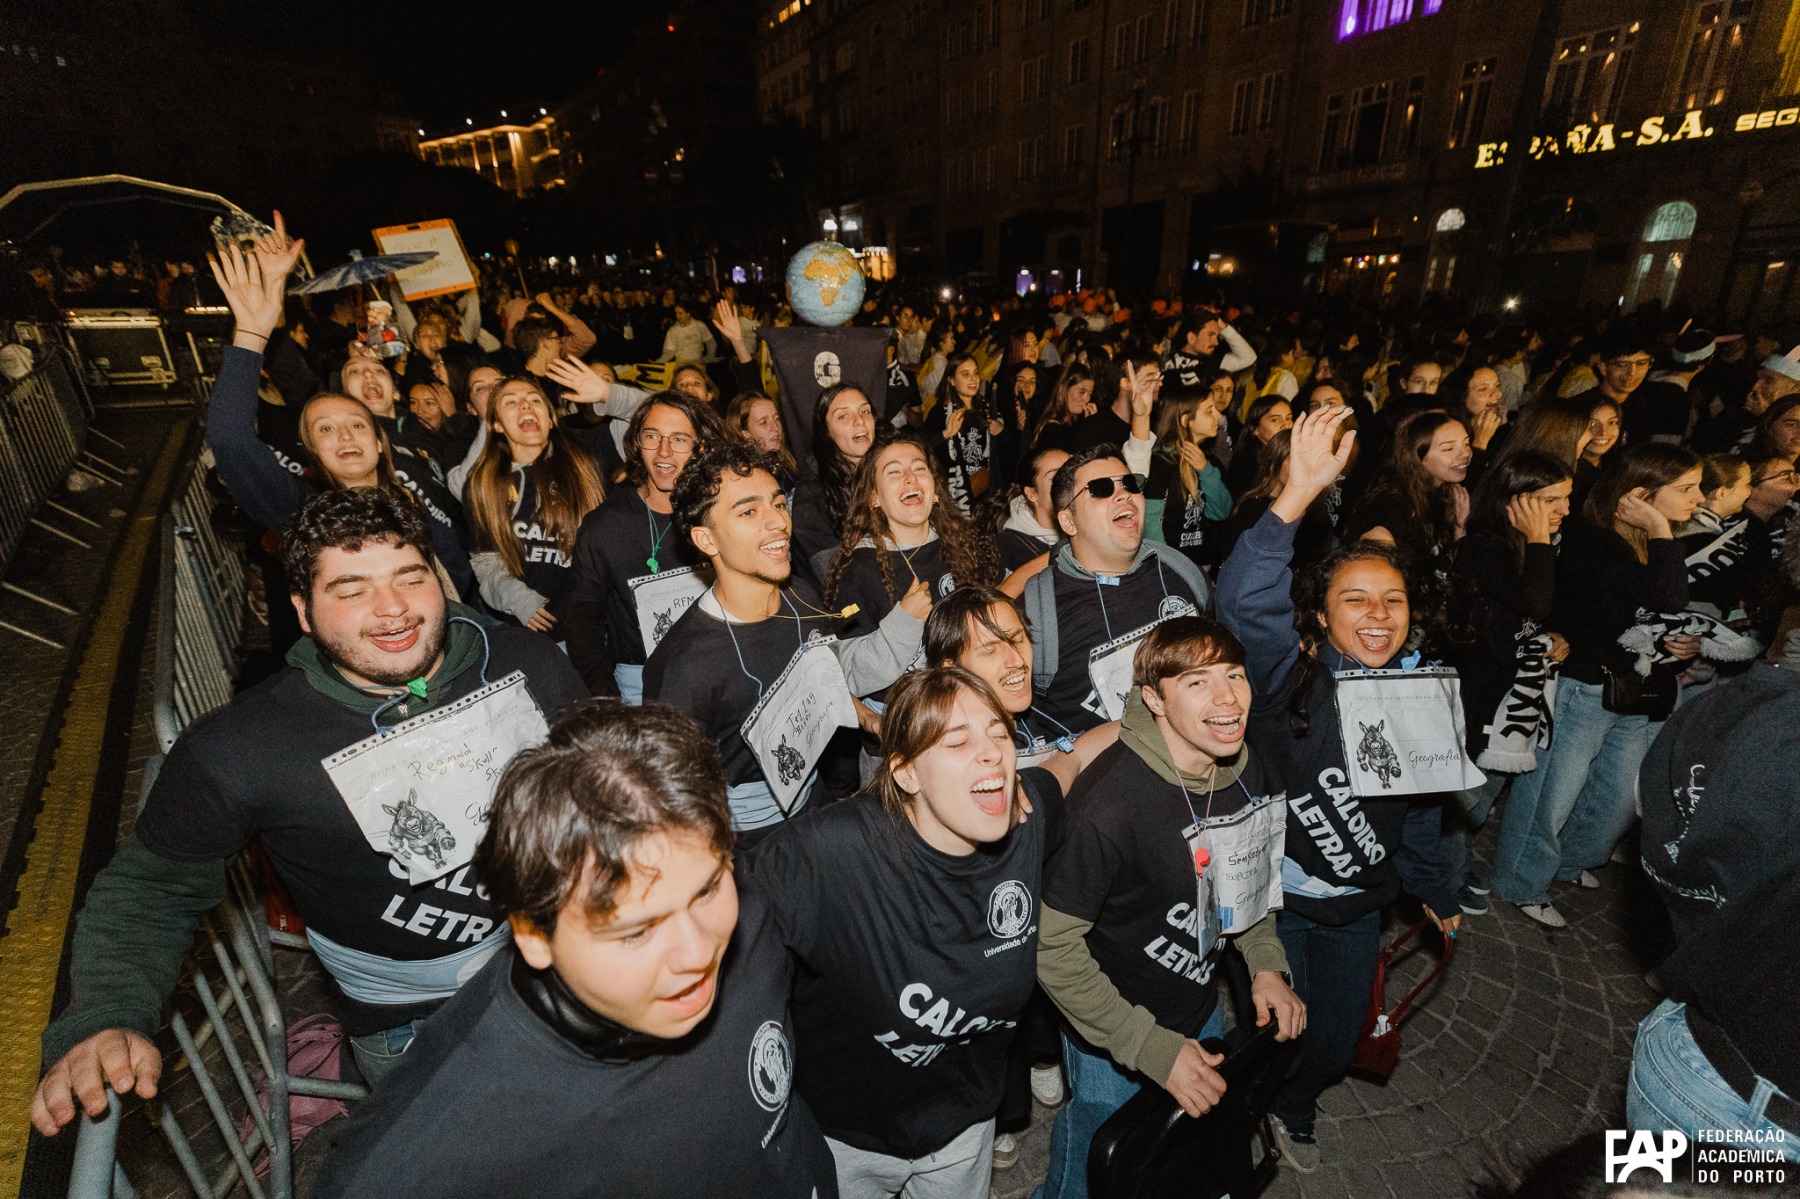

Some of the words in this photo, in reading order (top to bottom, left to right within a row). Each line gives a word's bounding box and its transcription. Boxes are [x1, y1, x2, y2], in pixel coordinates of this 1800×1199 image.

[1734, 107, 1800, 132] SEG
[1408, 749, 1461, 769] Geografia
[1289, 793, 1361, 879] LETRAS
[1318, 767, 1386, 865] CALOIRO
